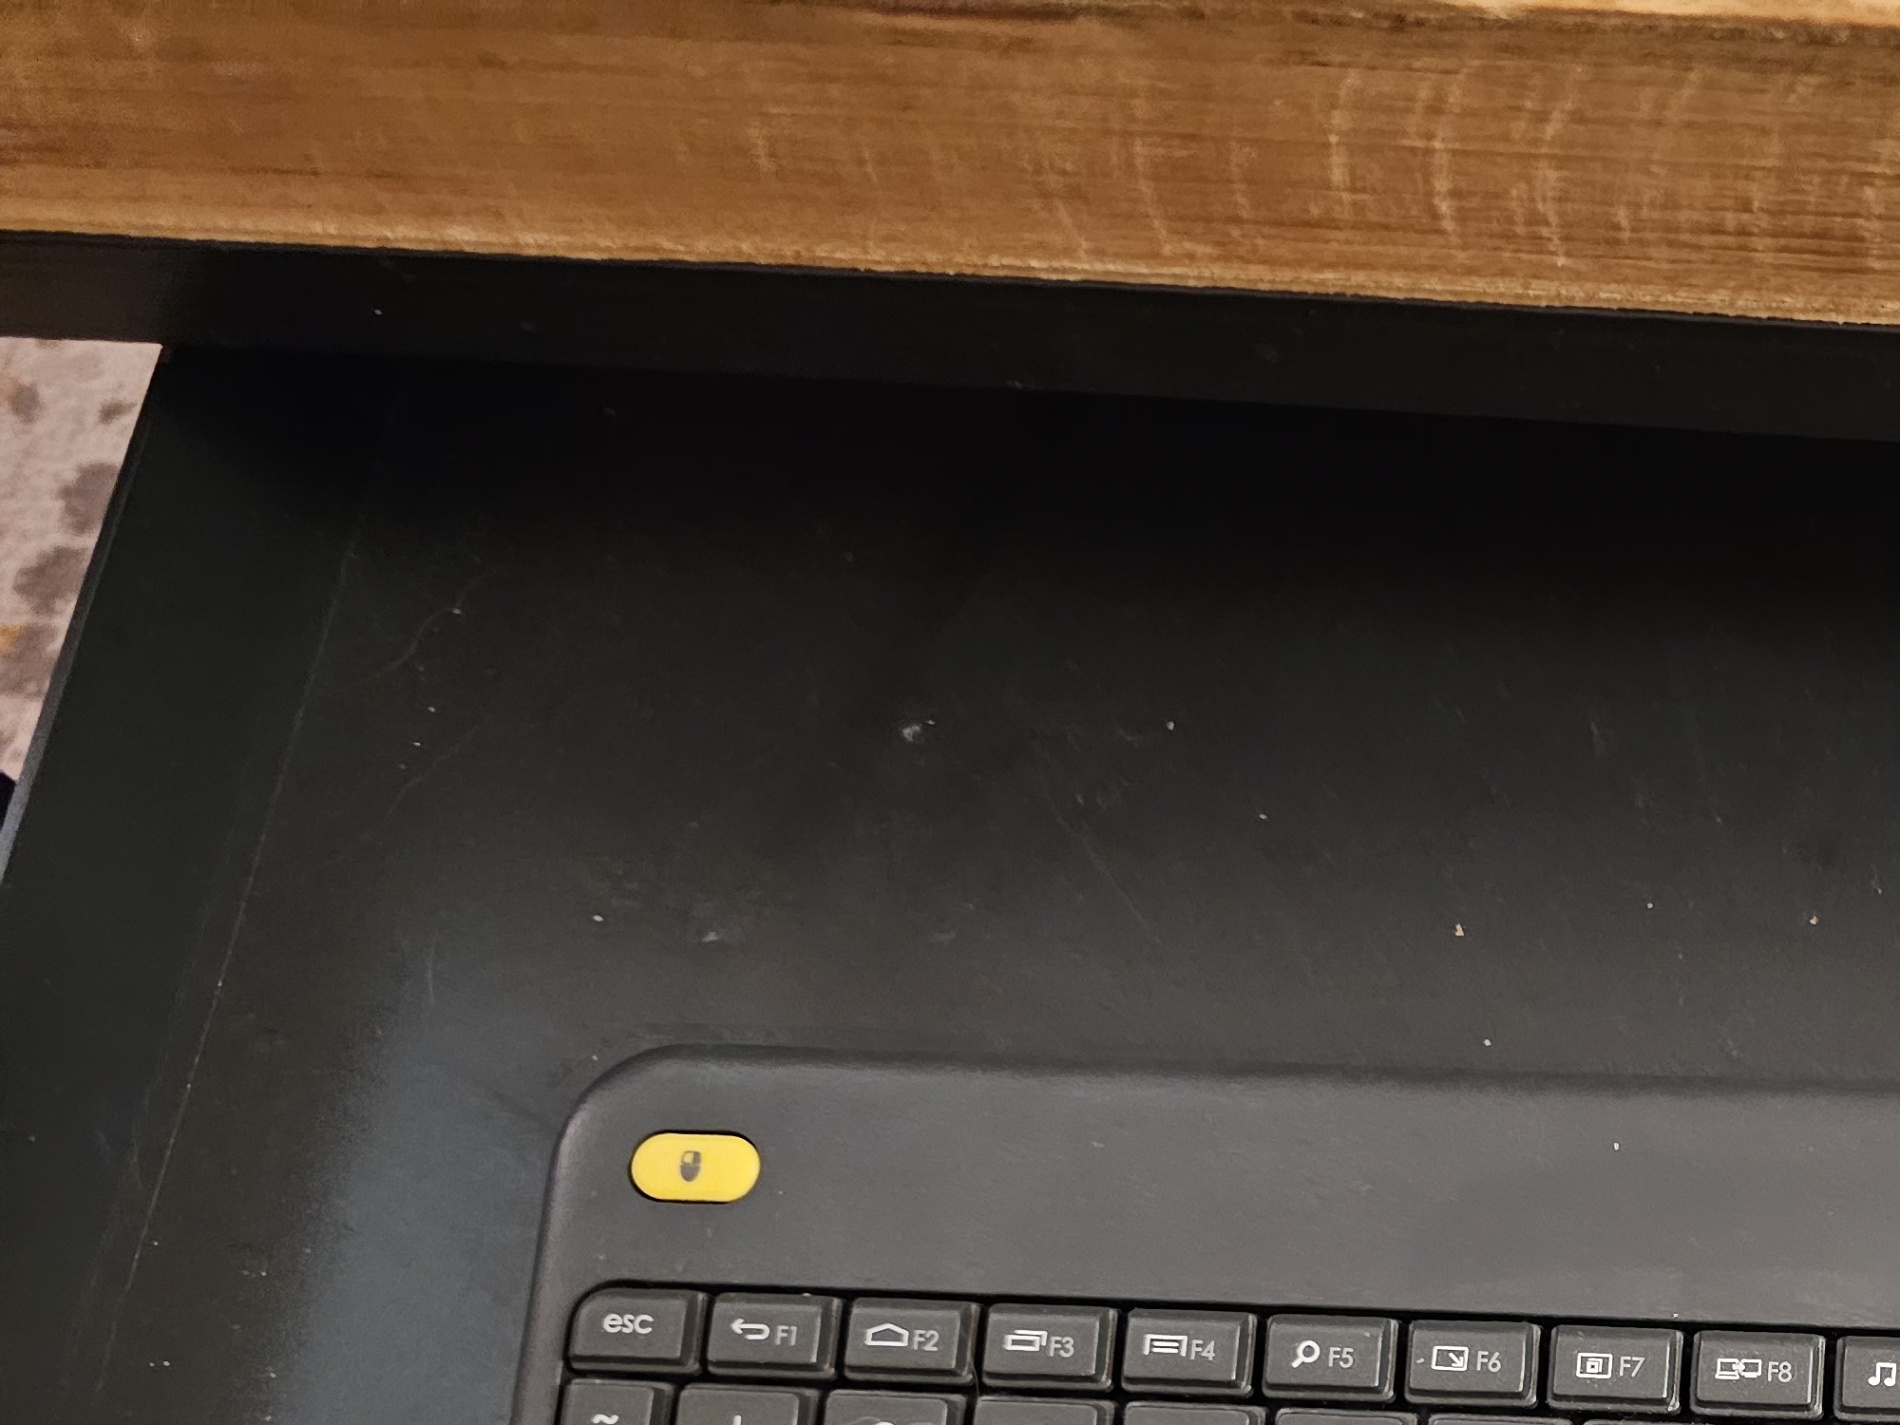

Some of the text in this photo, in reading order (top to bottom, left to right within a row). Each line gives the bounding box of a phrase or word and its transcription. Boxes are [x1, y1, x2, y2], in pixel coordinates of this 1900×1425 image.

[602, 1313, 654, 1335] esc
[774, 1324, 798, 1346] F1
[911, 1329, 940, 1352] F2
[1048, 1335, 1075, 1358] F3
[1190, 1338, 1216, 1361] F4
[1327, 1346, 1354, 1369] F5
[1475, 1349, 1502, 1373] F6
[1618, 1355, 1645, 1378] F7
[1767, 1360, 1793, 1383] F8
